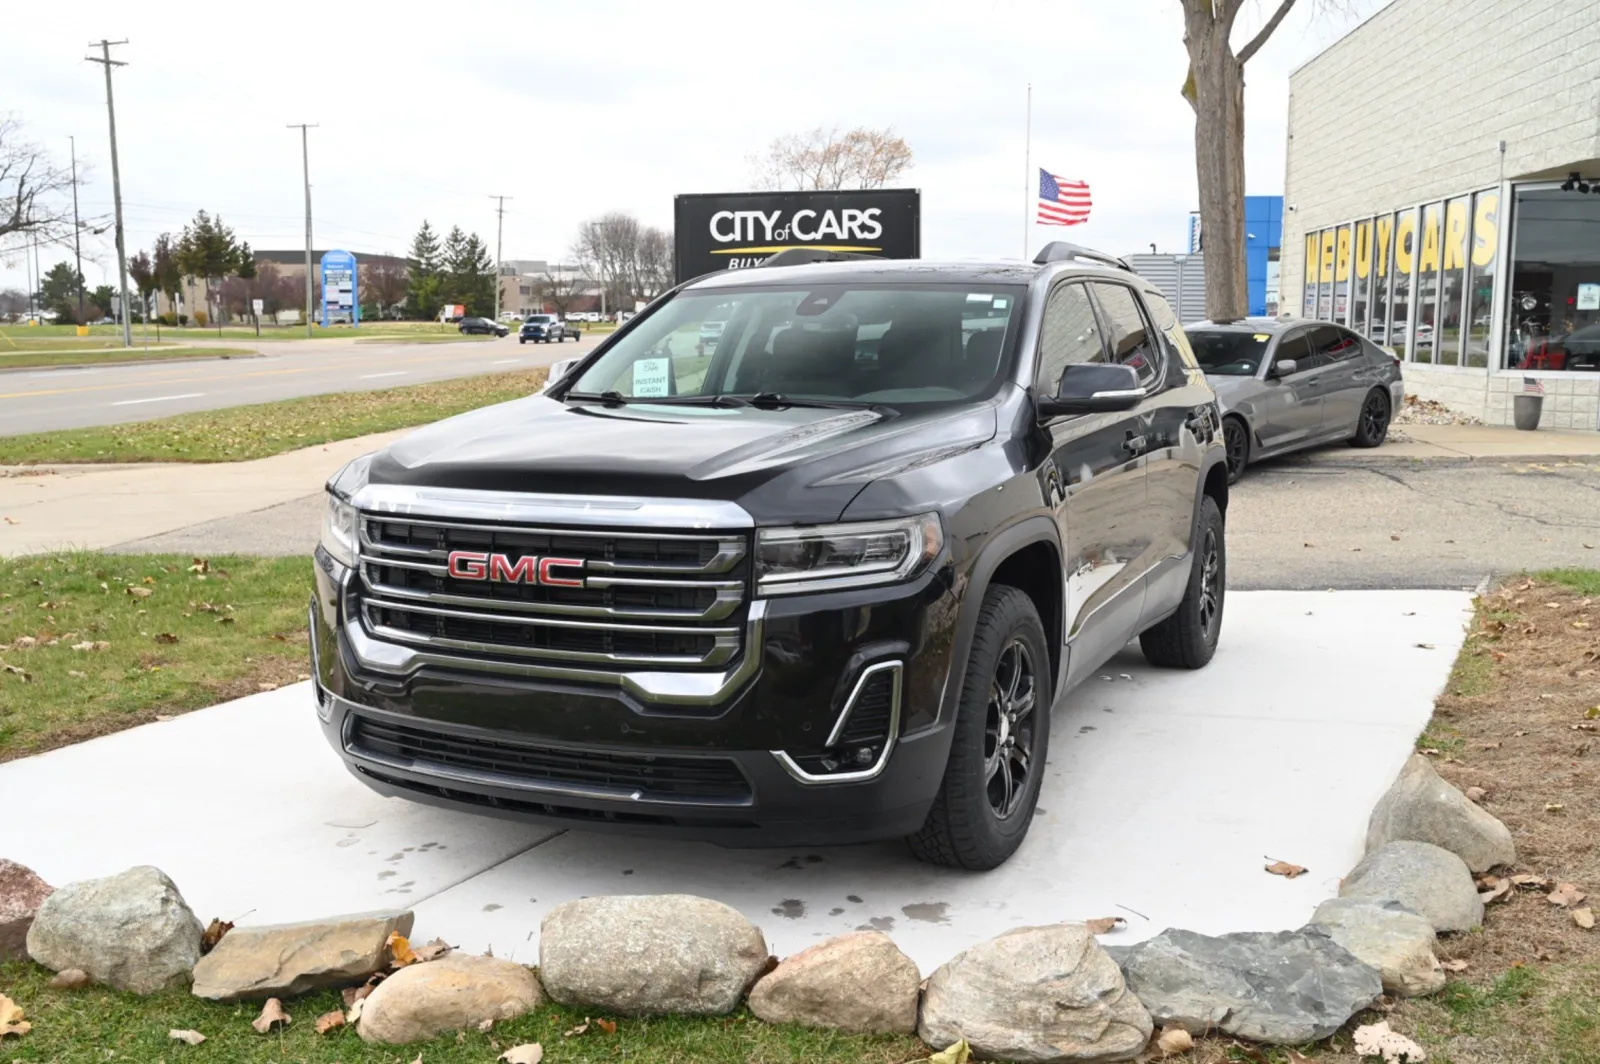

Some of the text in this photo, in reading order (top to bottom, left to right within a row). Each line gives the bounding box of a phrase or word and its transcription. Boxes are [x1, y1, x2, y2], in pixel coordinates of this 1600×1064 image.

[709, 208, 883, 242] CITY of CARS
[1336, 219, 1392, 282] BUY
[1394, 195, 1499, 275] CARS
[728, 257, 768, 270] BUY
[635, 376, 666, 385] INSTANT
[448, 551, 585, 588] GMC
